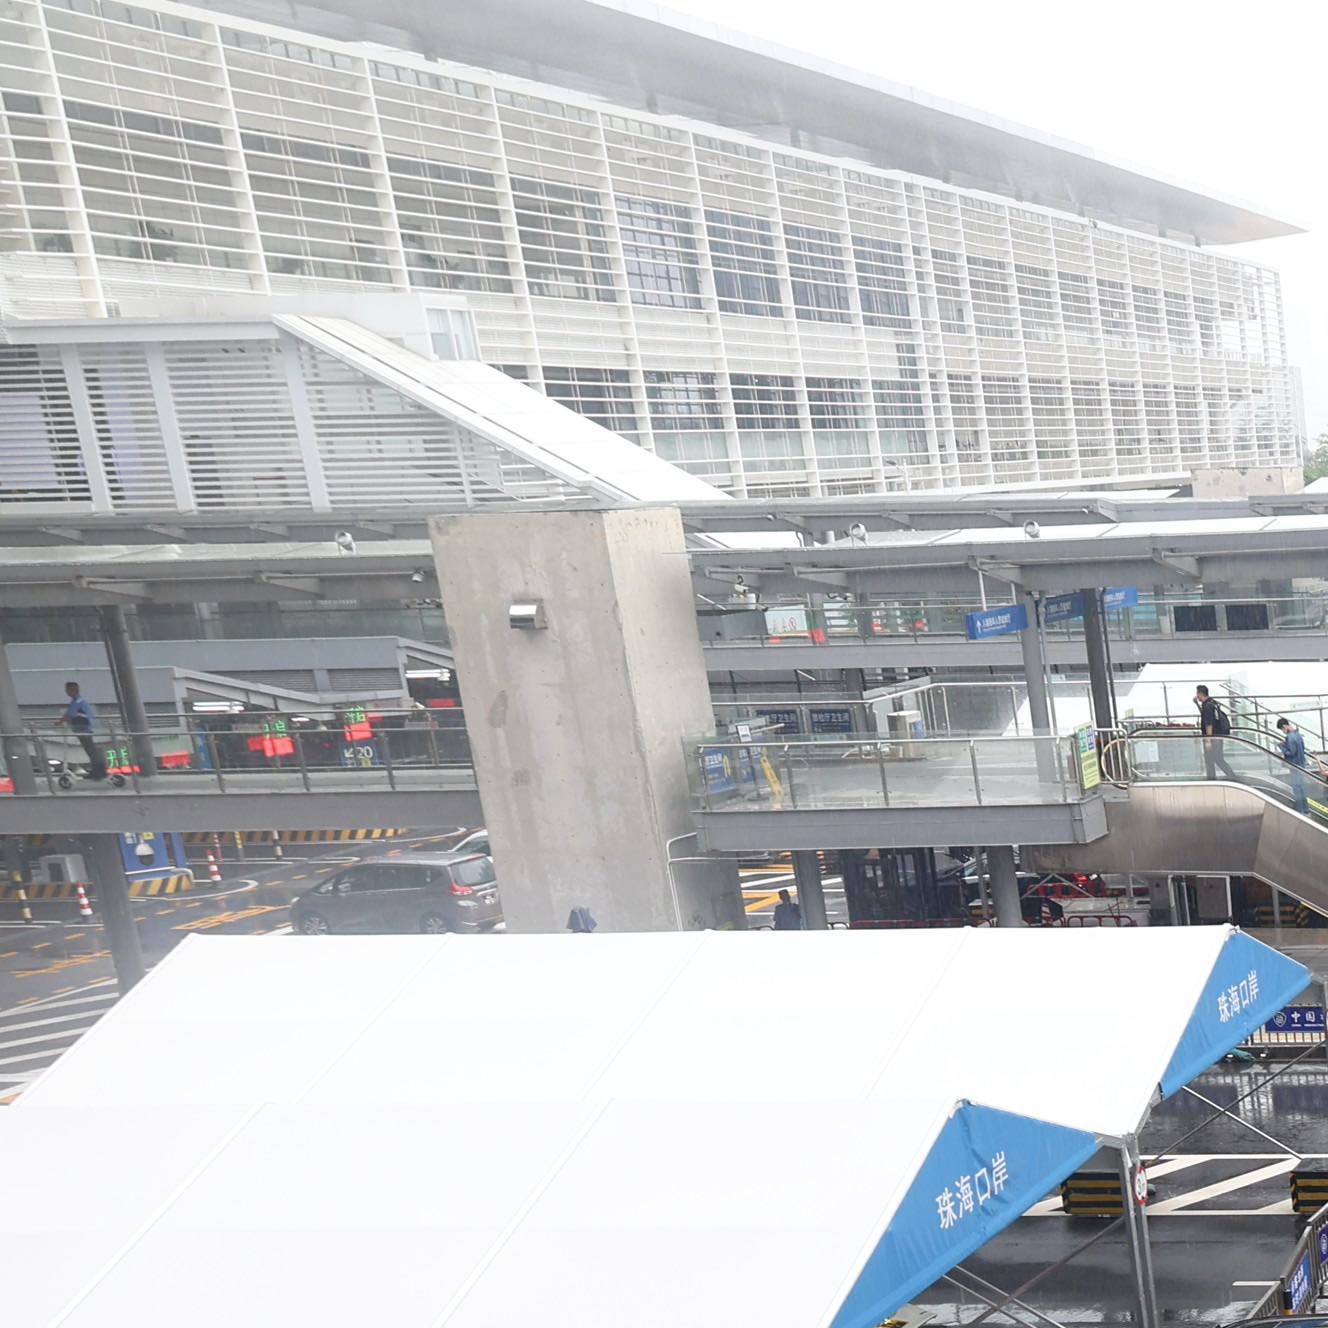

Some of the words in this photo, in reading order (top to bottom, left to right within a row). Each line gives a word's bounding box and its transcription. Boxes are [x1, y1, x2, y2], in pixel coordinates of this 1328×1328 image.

[1217, 970, 1259, 1023] 珠海口岸
[936, 1151, 1008, 1230] 珠海口岸
